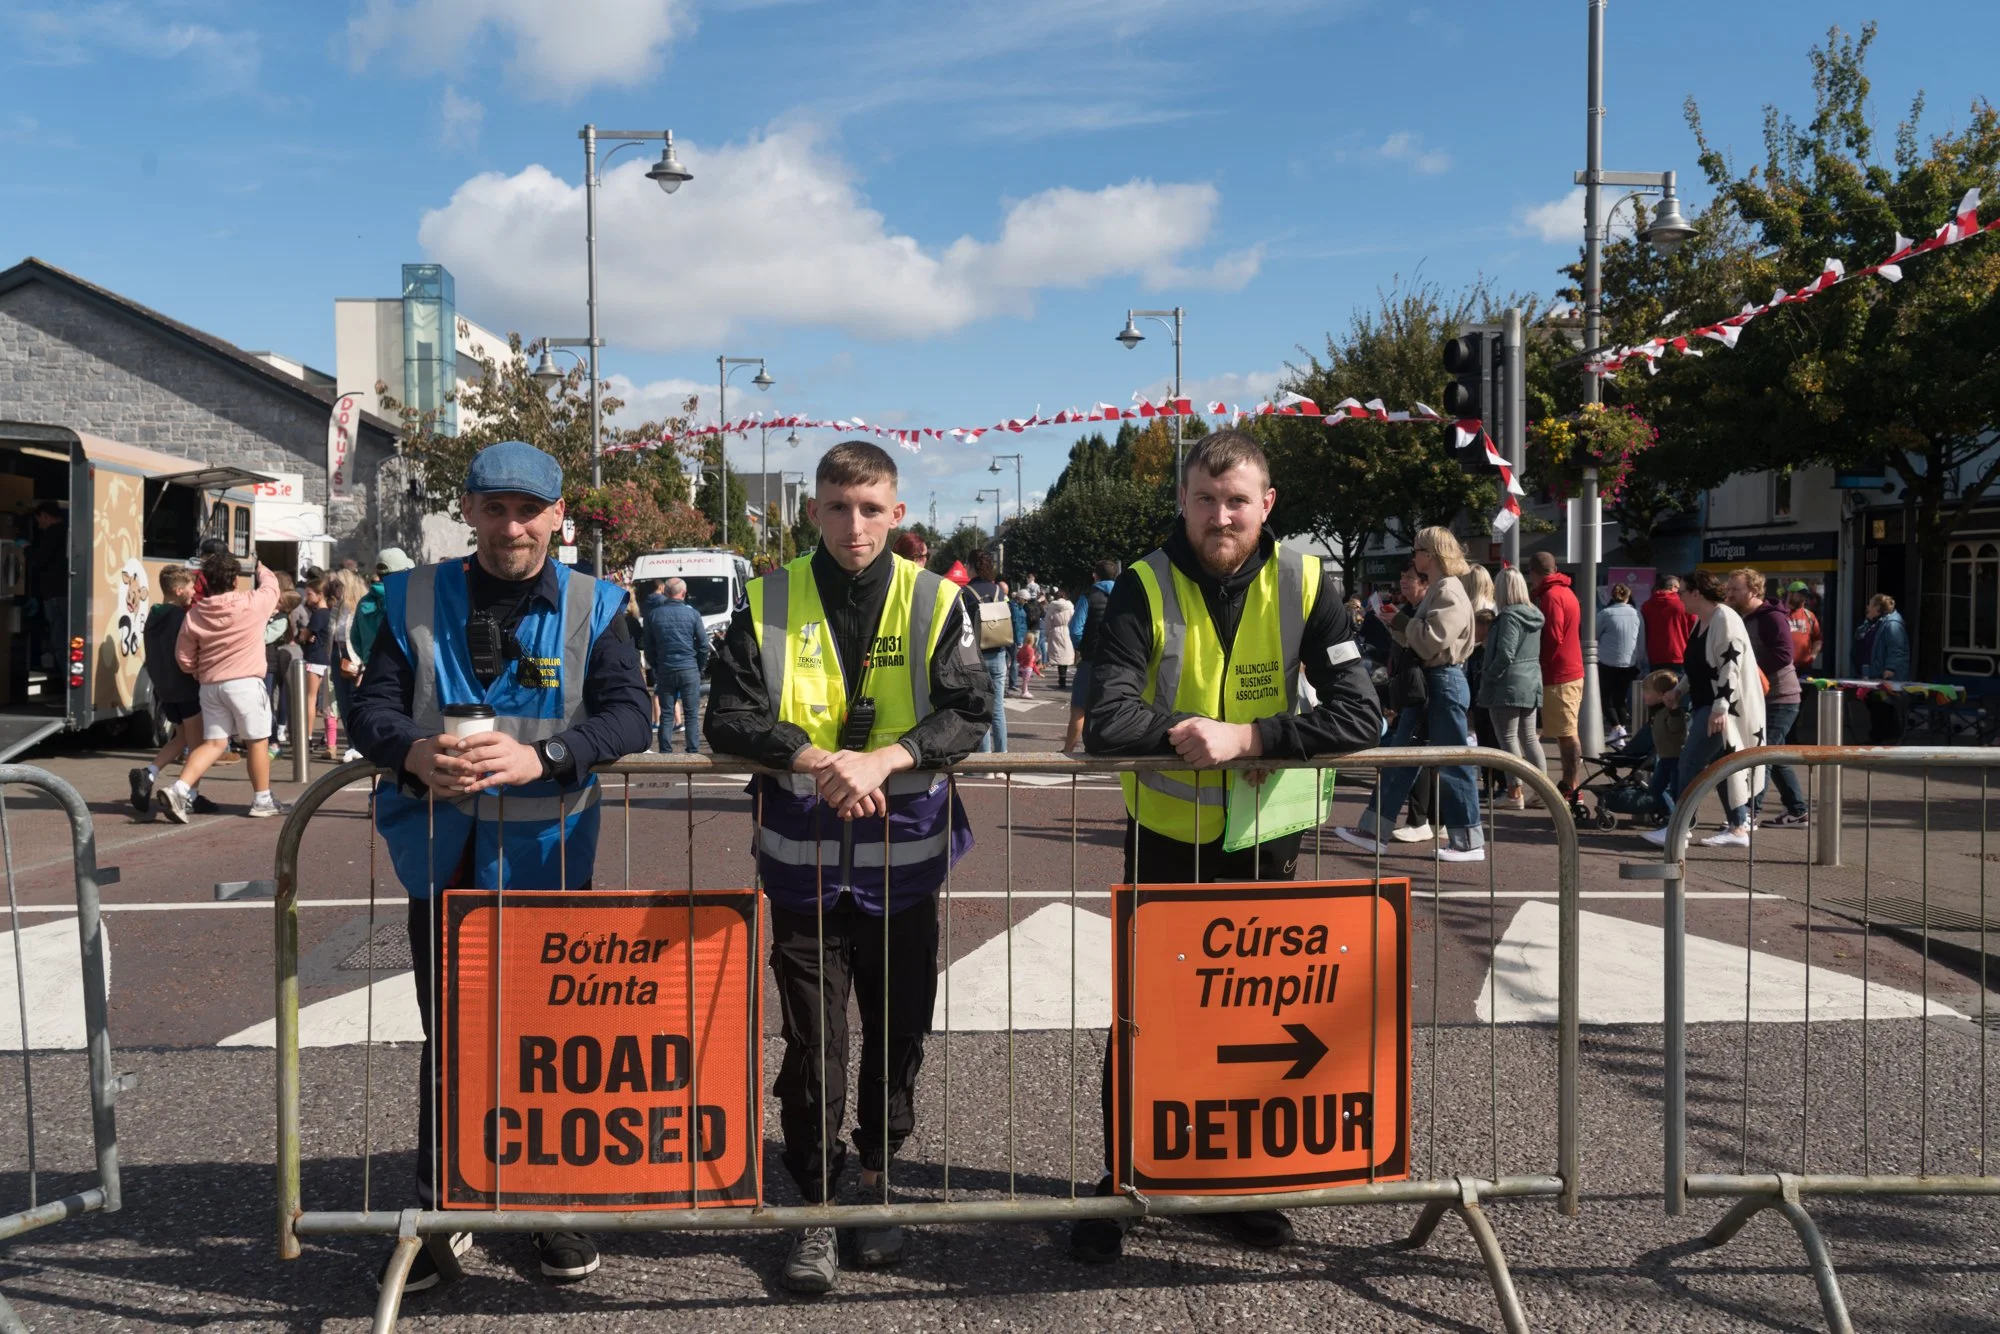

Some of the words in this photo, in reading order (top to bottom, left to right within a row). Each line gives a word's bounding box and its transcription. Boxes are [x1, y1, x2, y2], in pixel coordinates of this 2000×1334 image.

[1709, 543, 1746, 560] Dorgan
[648, 557, 715, 565] AMBULANCE
[876, 635, 902, 653] 2031
[798, 656, 822, 664] TEKKEN
[870, 654, 905, 669] STEWARD
[1235, 661, 1279, 675] BALLINCOLLIG
[1240, 675, 1272, 688] BUSINESS
[1235, 687, 1279, 701] ASSOCIATION
[1202, 916, 1329, 959] Cúrsa
[540, 931, 669, 964] Bóthar
[548, 973, 659, 1006] Dúnta
[1195, 963, 1340, 1016] Timpill
[519, 1034, 692, 1094] ROAD
[1153, 1091, 1374, 1160] DETOUR
[483, 1105, 727, 1166] CLOSED
